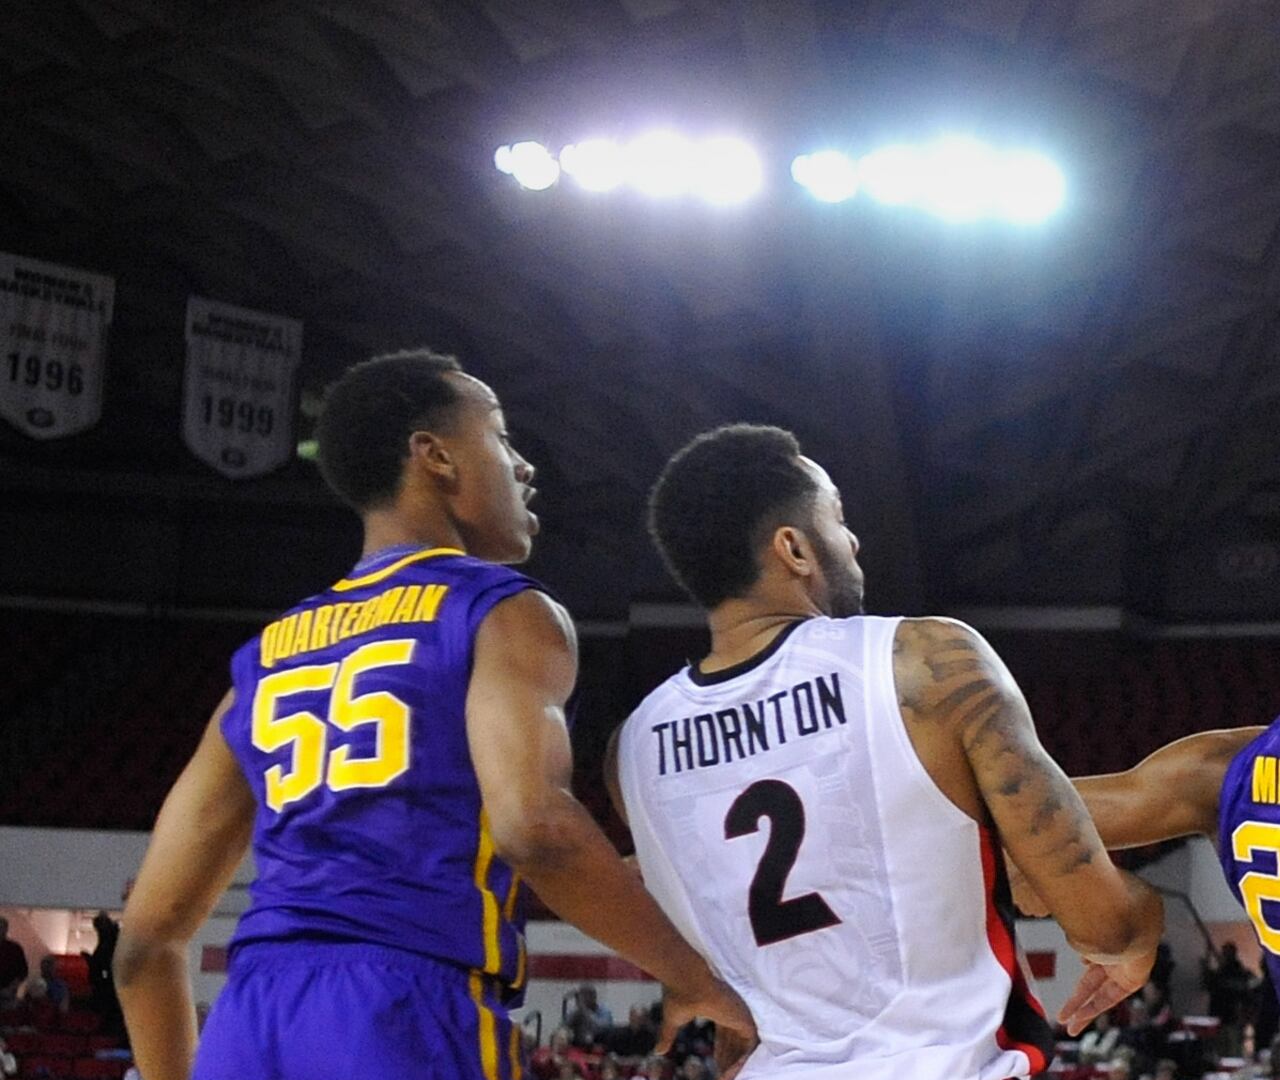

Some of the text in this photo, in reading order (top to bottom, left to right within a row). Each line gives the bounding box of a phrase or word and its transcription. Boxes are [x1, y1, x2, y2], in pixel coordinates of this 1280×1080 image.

[8, 352, 84, 396] 1996
[201, 396, 275, 438] 1999
[260, 584, 449, 669] QUARTERMAN
[251, 638, 417, 814] 55
[651, 672, 847, 776] THORNTON
[723, 778, 843, 948] 2
